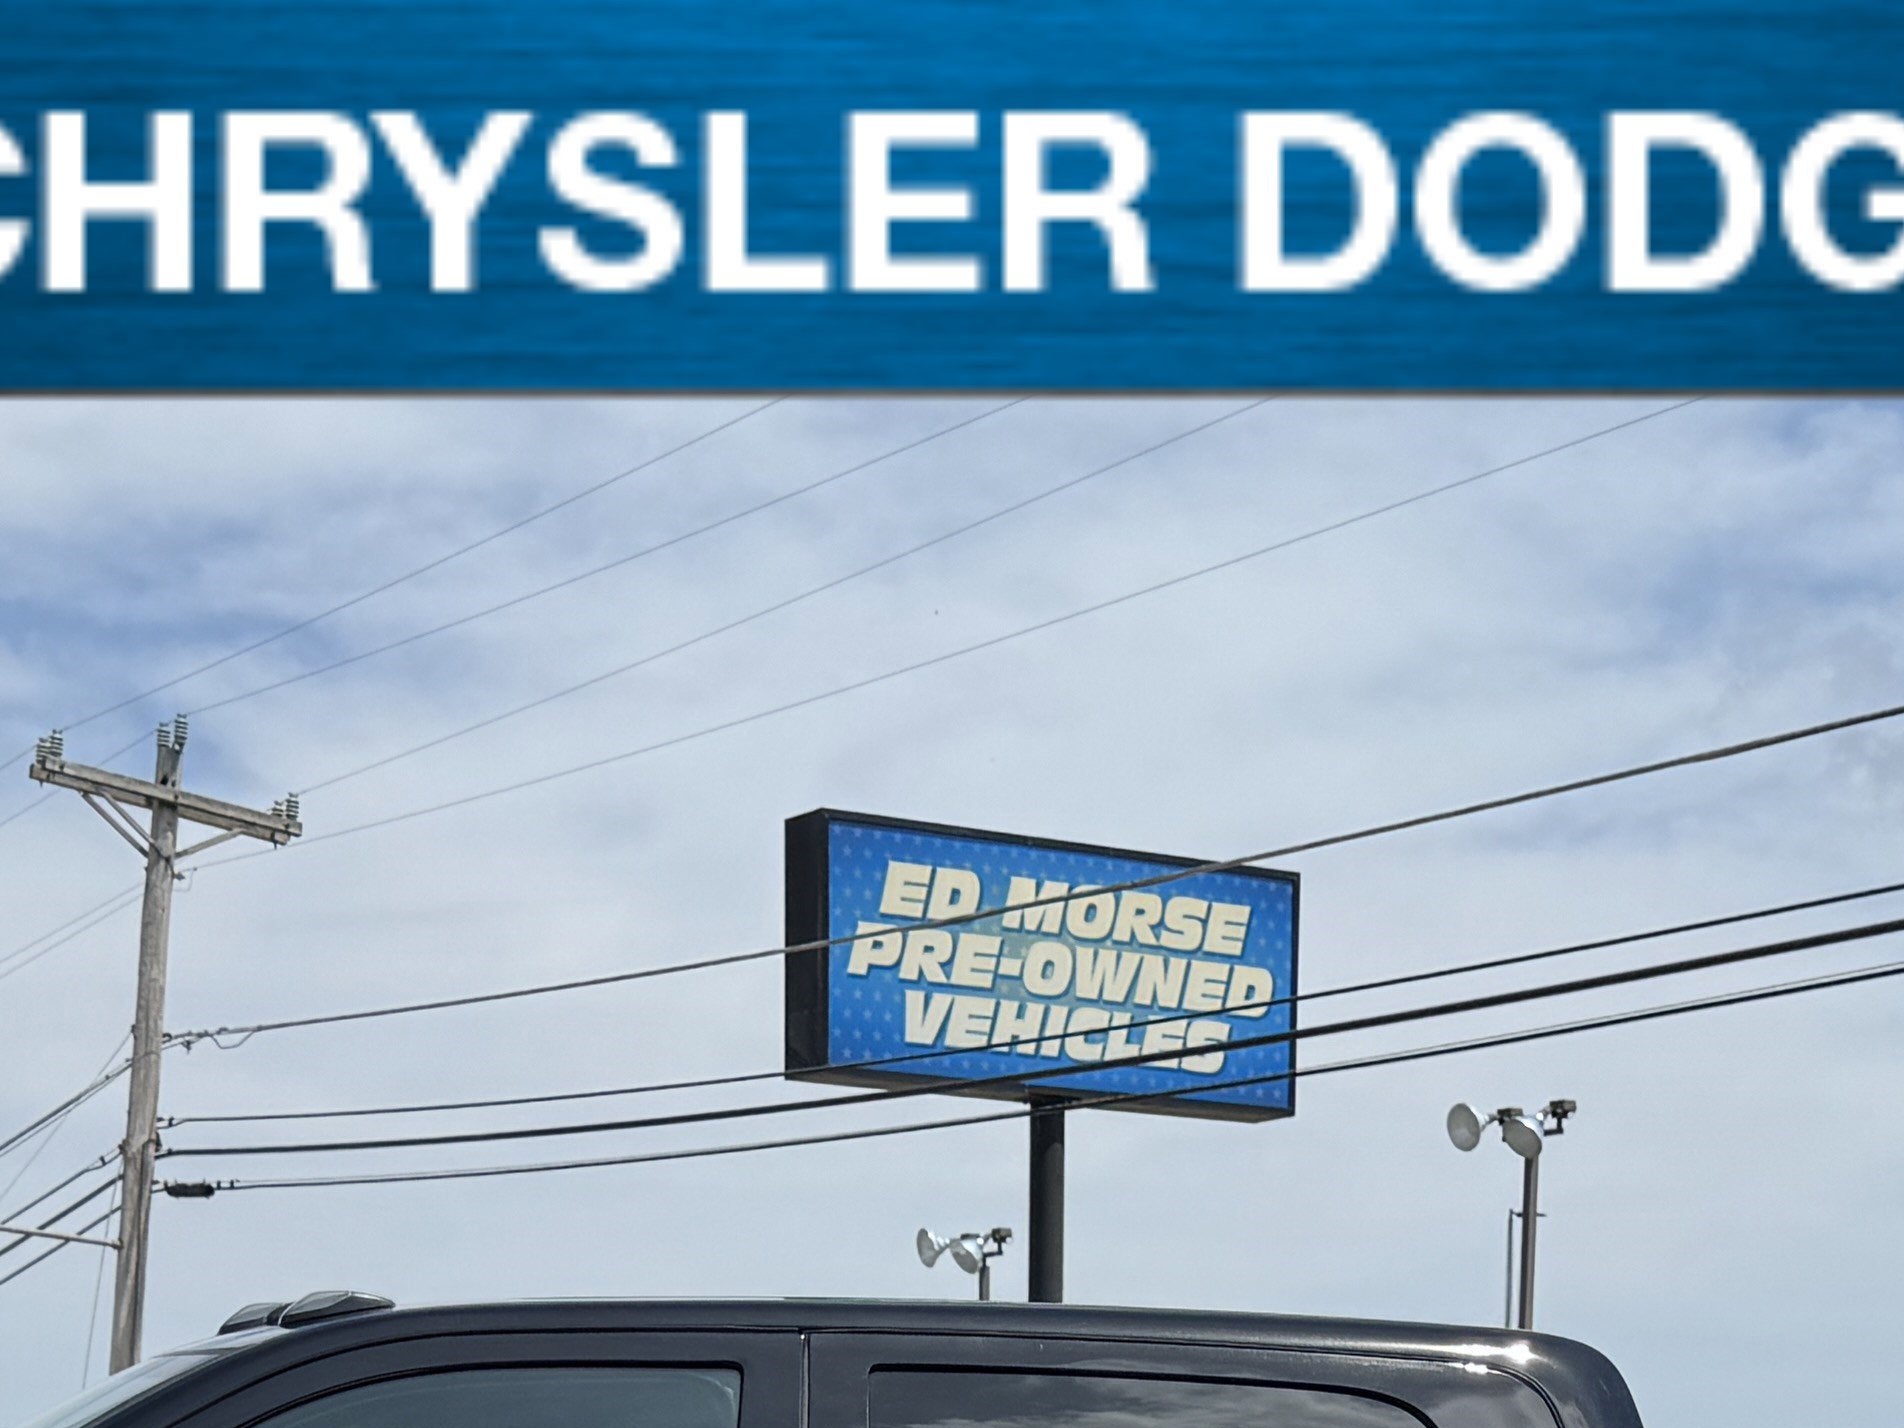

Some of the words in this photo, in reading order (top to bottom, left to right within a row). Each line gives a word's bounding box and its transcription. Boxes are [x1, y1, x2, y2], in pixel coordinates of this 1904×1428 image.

[879, 860, 981, 926] ED
[1003, 875, 1252, 957] MORSE
[847, 920, 1275, 1018] PRE-OWNED
[902, 988, 1232, 1076] VEHICLES
